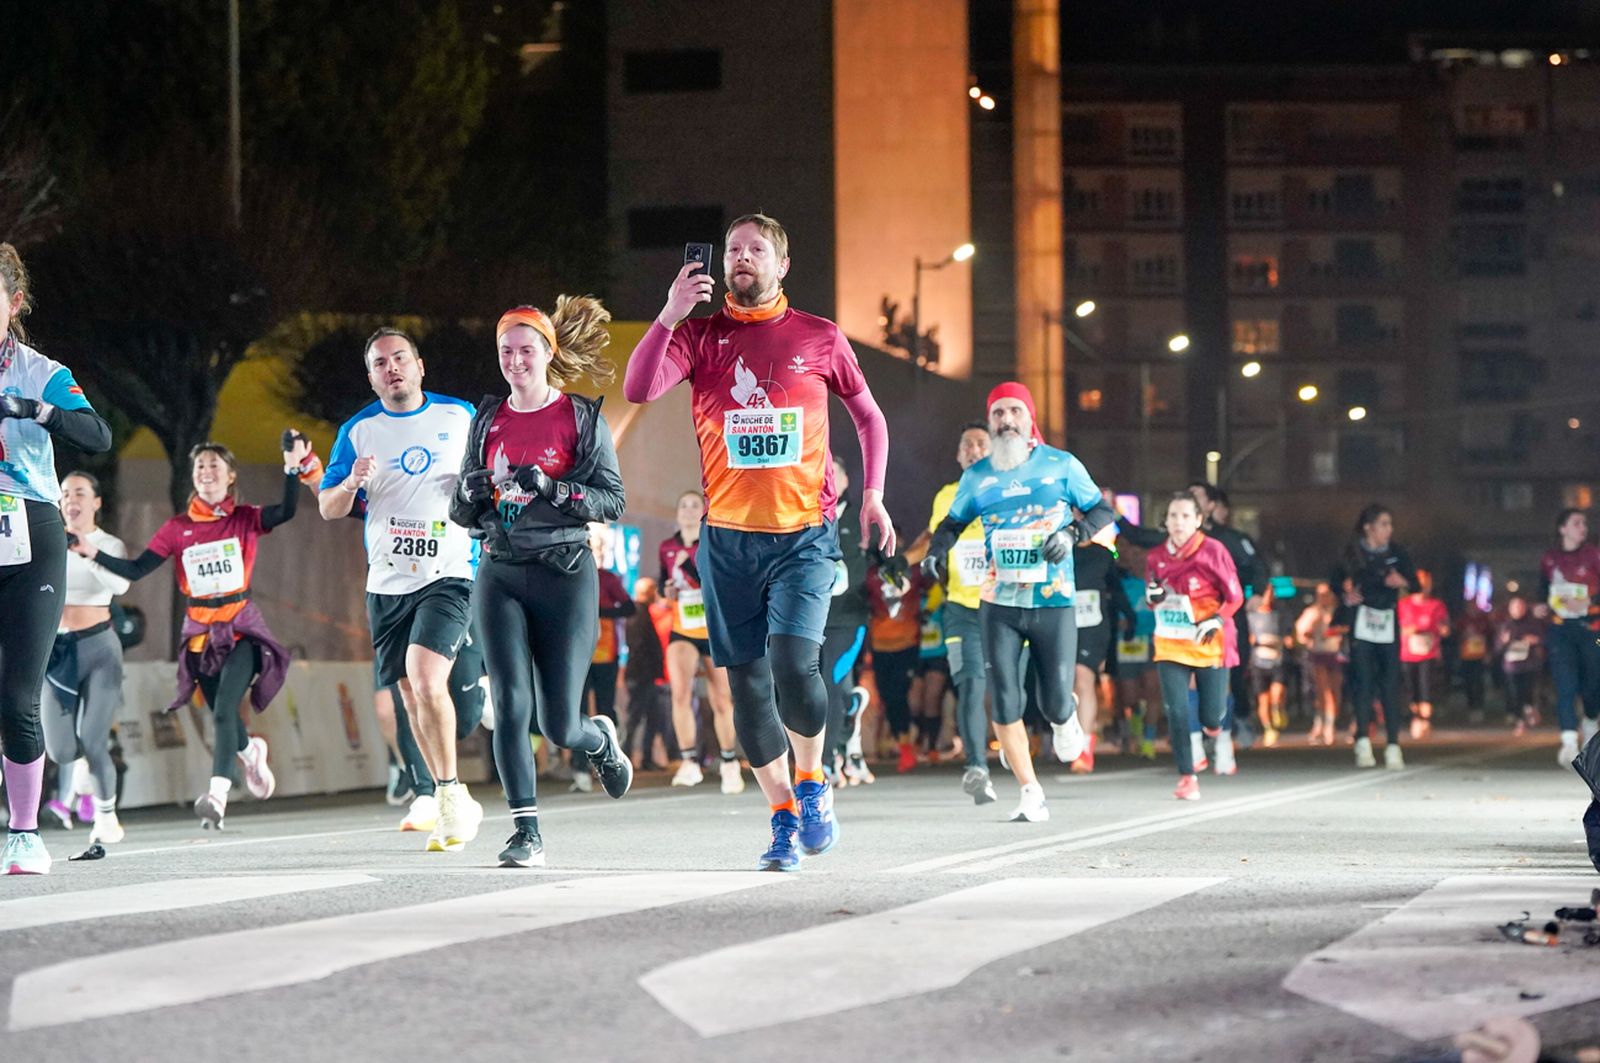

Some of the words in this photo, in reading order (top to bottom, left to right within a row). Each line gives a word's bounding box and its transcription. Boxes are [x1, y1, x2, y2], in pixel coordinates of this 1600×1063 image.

[740, 416, 763, 425] NOCHE
[764, 416, 774, 424] DE
[731, 426, 747, 434] SAN
[747, 425, 774, 434] ANTÓN
[739, 434, 788, 457] 9367
[397, 521, 417, 529] NOCHE
[392, 536, 439, 558] 2389
[964, 557, 989, 570] 275
[1000, 549, 1038, 564] 13775
[197, 559, 233, 577] 4446
